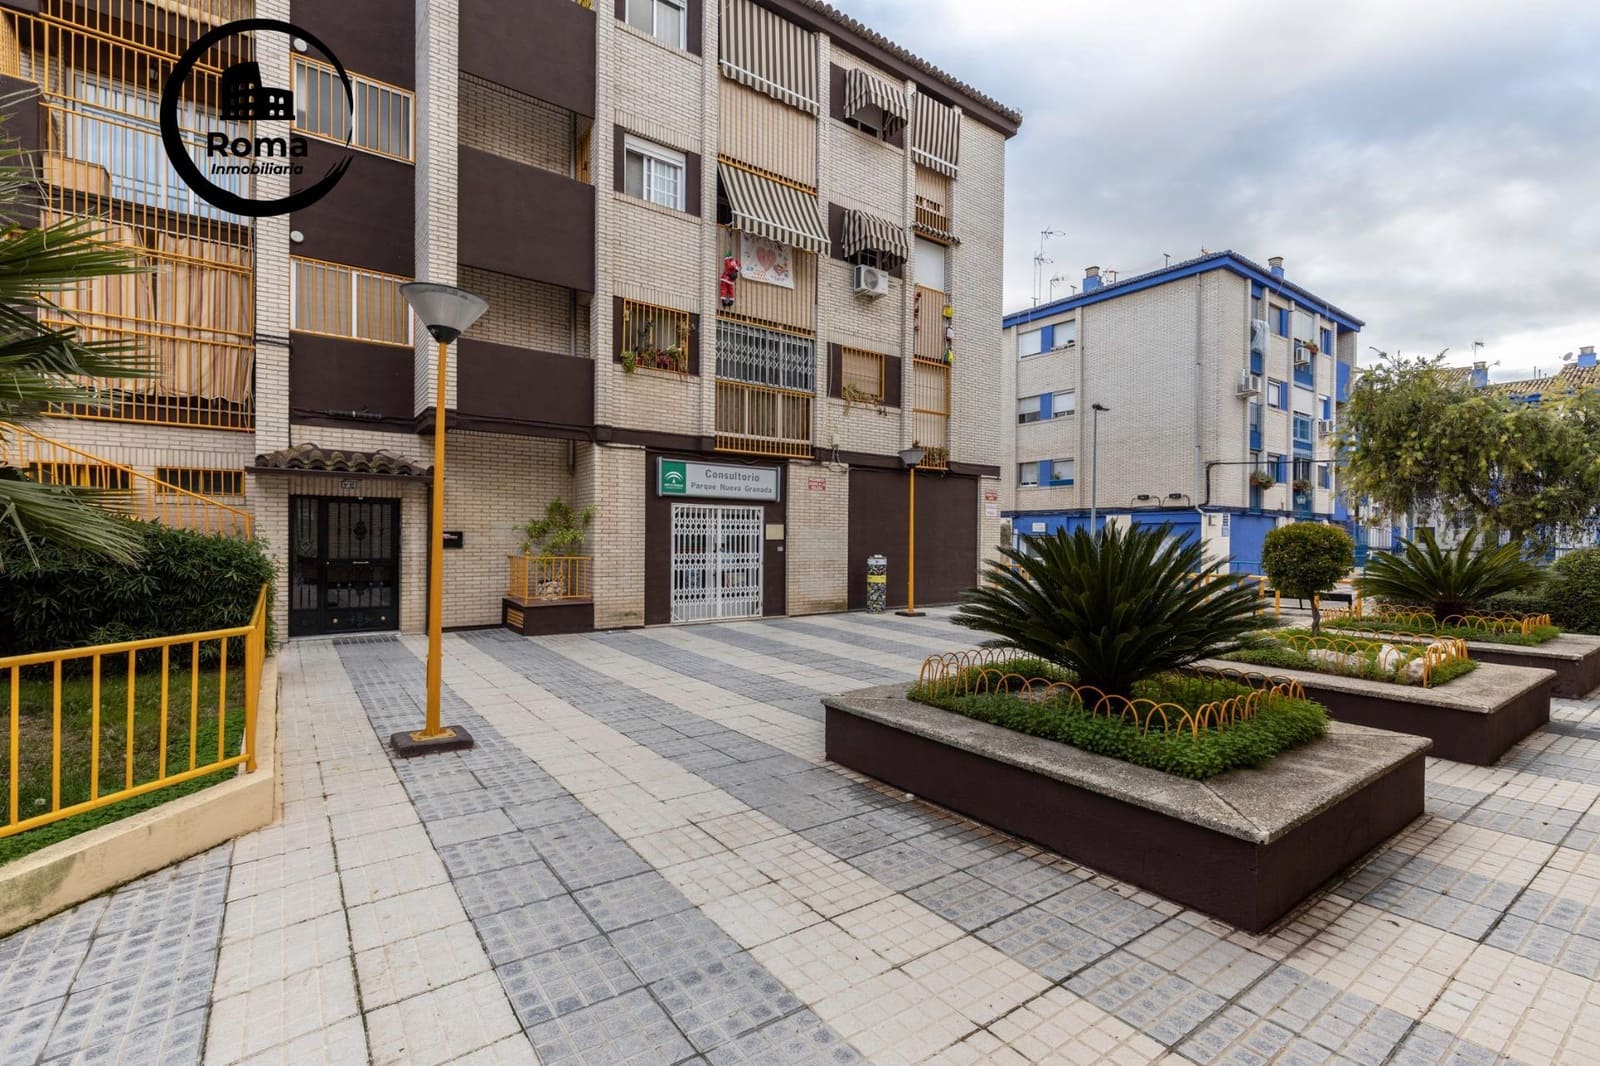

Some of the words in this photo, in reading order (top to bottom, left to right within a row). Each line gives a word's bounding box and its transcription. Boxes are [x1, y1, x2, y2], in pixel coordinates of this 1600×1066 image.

[705, 469, 760, 482] Consultorio
[691, 482, 716, 491] Parque
[720, 483, 741, 492] Nueva
[744, 485, 772, 493] Granada
